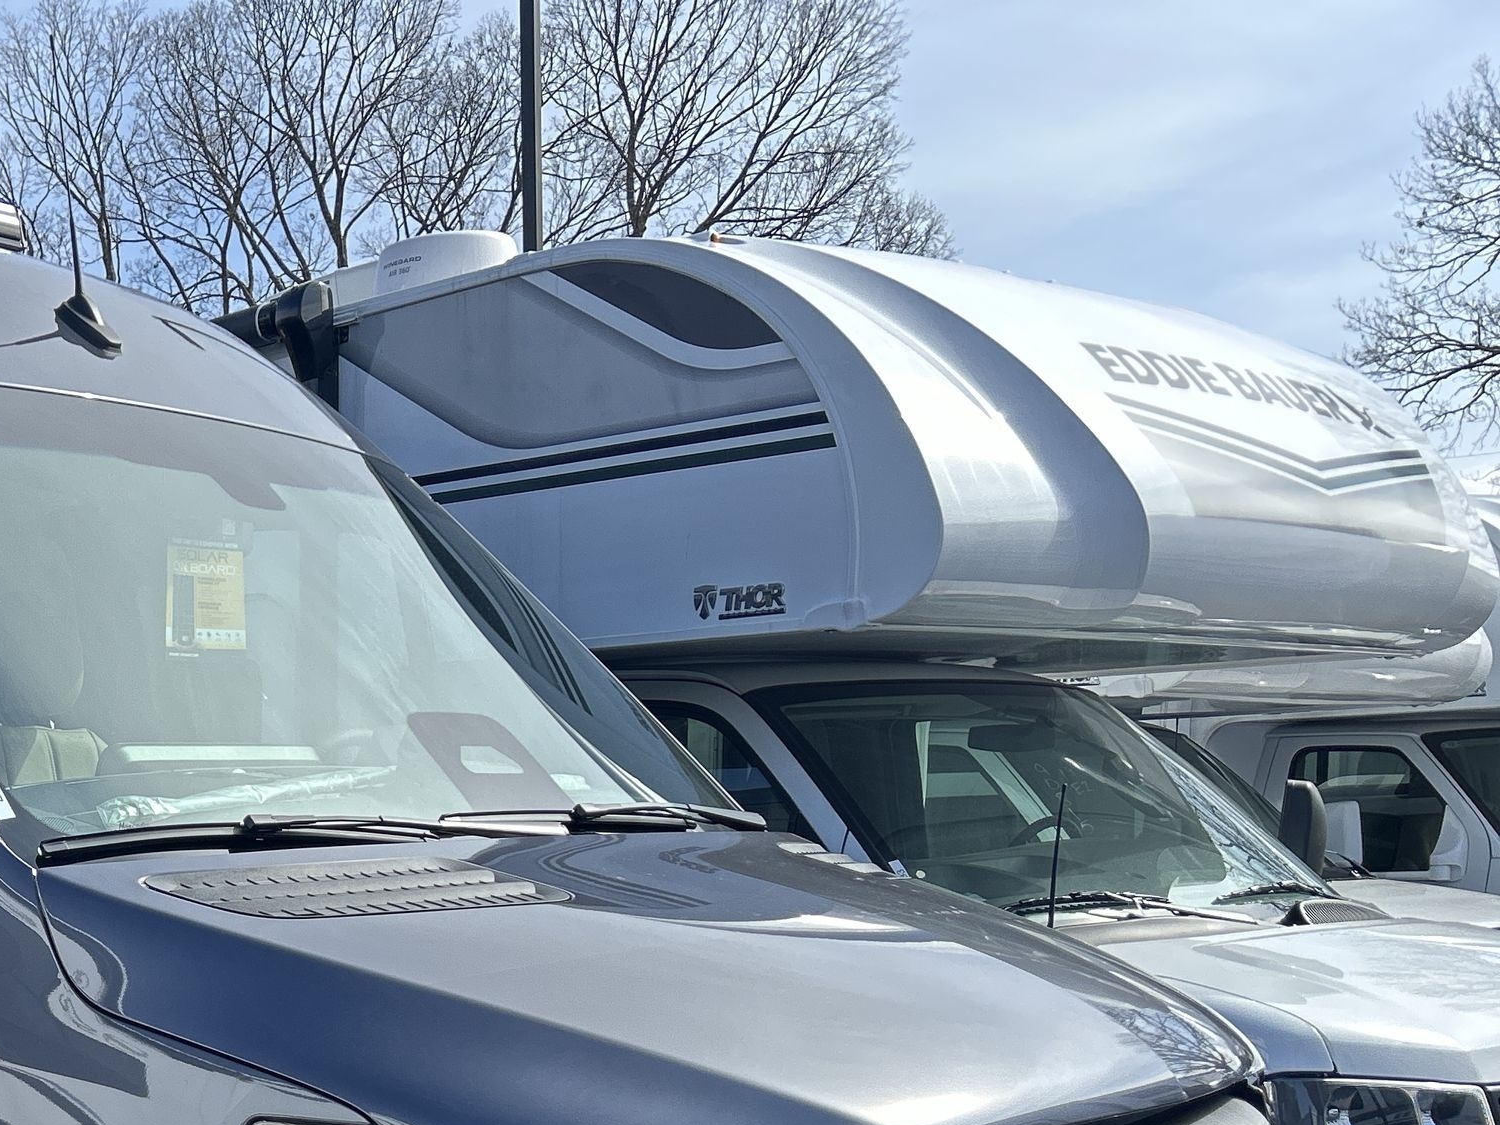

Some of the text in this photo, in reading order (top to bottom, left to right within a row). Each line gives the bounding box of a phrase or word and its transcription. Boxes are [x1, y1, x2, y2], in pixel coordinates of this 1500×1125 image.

[1078, 341, 1355, 424] EDDIE BAUER
[719, 582, 786, 612] THOR
